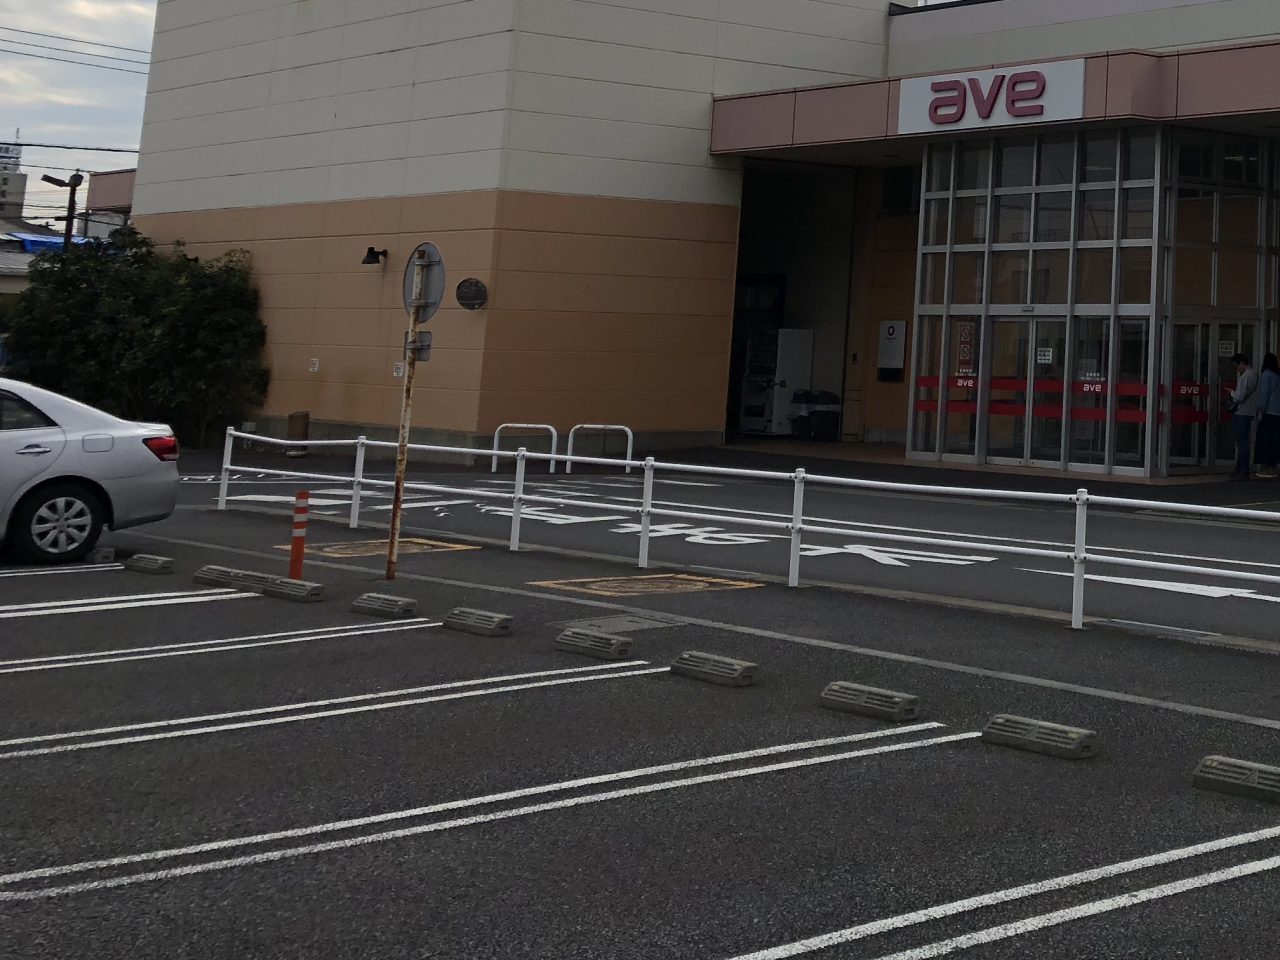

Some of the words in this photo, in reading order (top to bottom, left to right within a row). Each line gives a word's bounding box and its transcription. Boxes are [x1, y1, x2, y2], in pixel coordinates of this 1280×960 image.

[929, 70, 1046, 124] ave
[956, 378, 974, 387] ave
[1083, 383, 1102, 392] ave
[1180, 386, 1199, 394] ave
[480, 505, 999, 567] 止まれ
